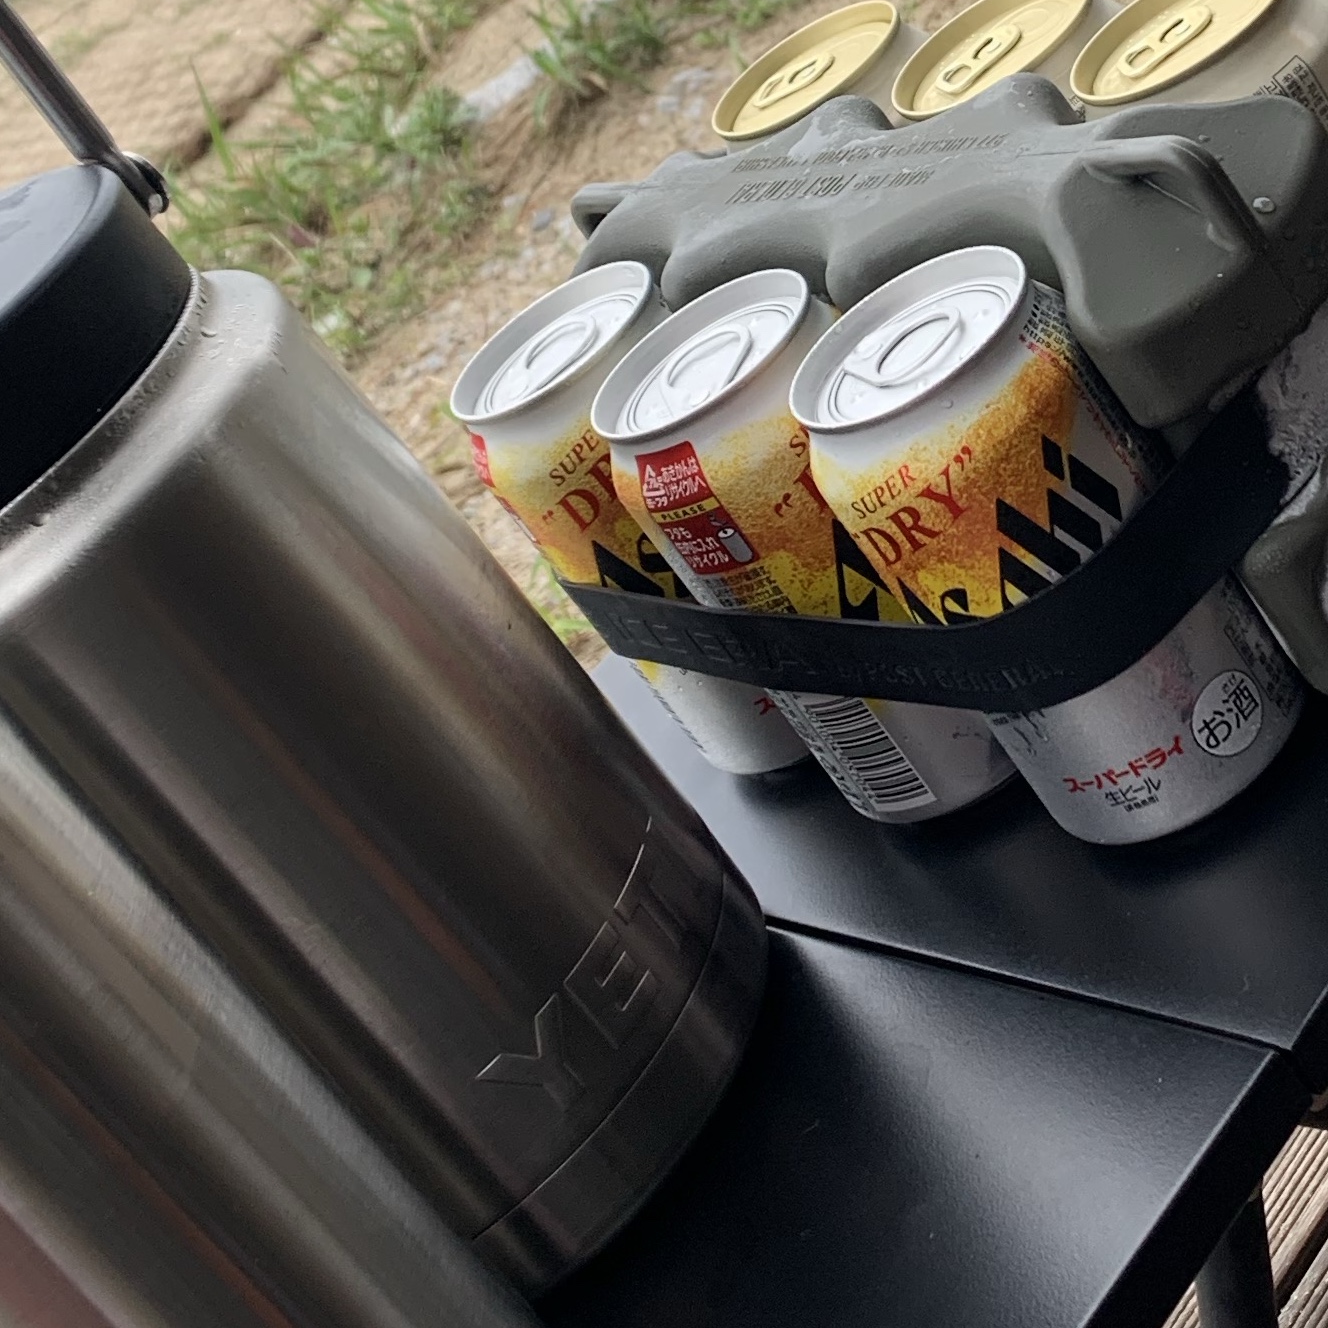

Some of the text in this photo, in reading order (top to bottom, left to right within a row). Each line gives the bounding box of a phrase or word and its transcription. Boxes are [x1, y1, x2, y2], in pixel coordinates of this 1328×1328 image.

[549, 429, 600, 487] SUPE
[661, 504, 706, 520] PLEASE
[851, 464, 916, 520] SUPER
[1198, 678, 1259, 748] お酒
[1064, 735, 1184, 794] スーパードライ
[1105, 777, 1162, 807] 生ビール
